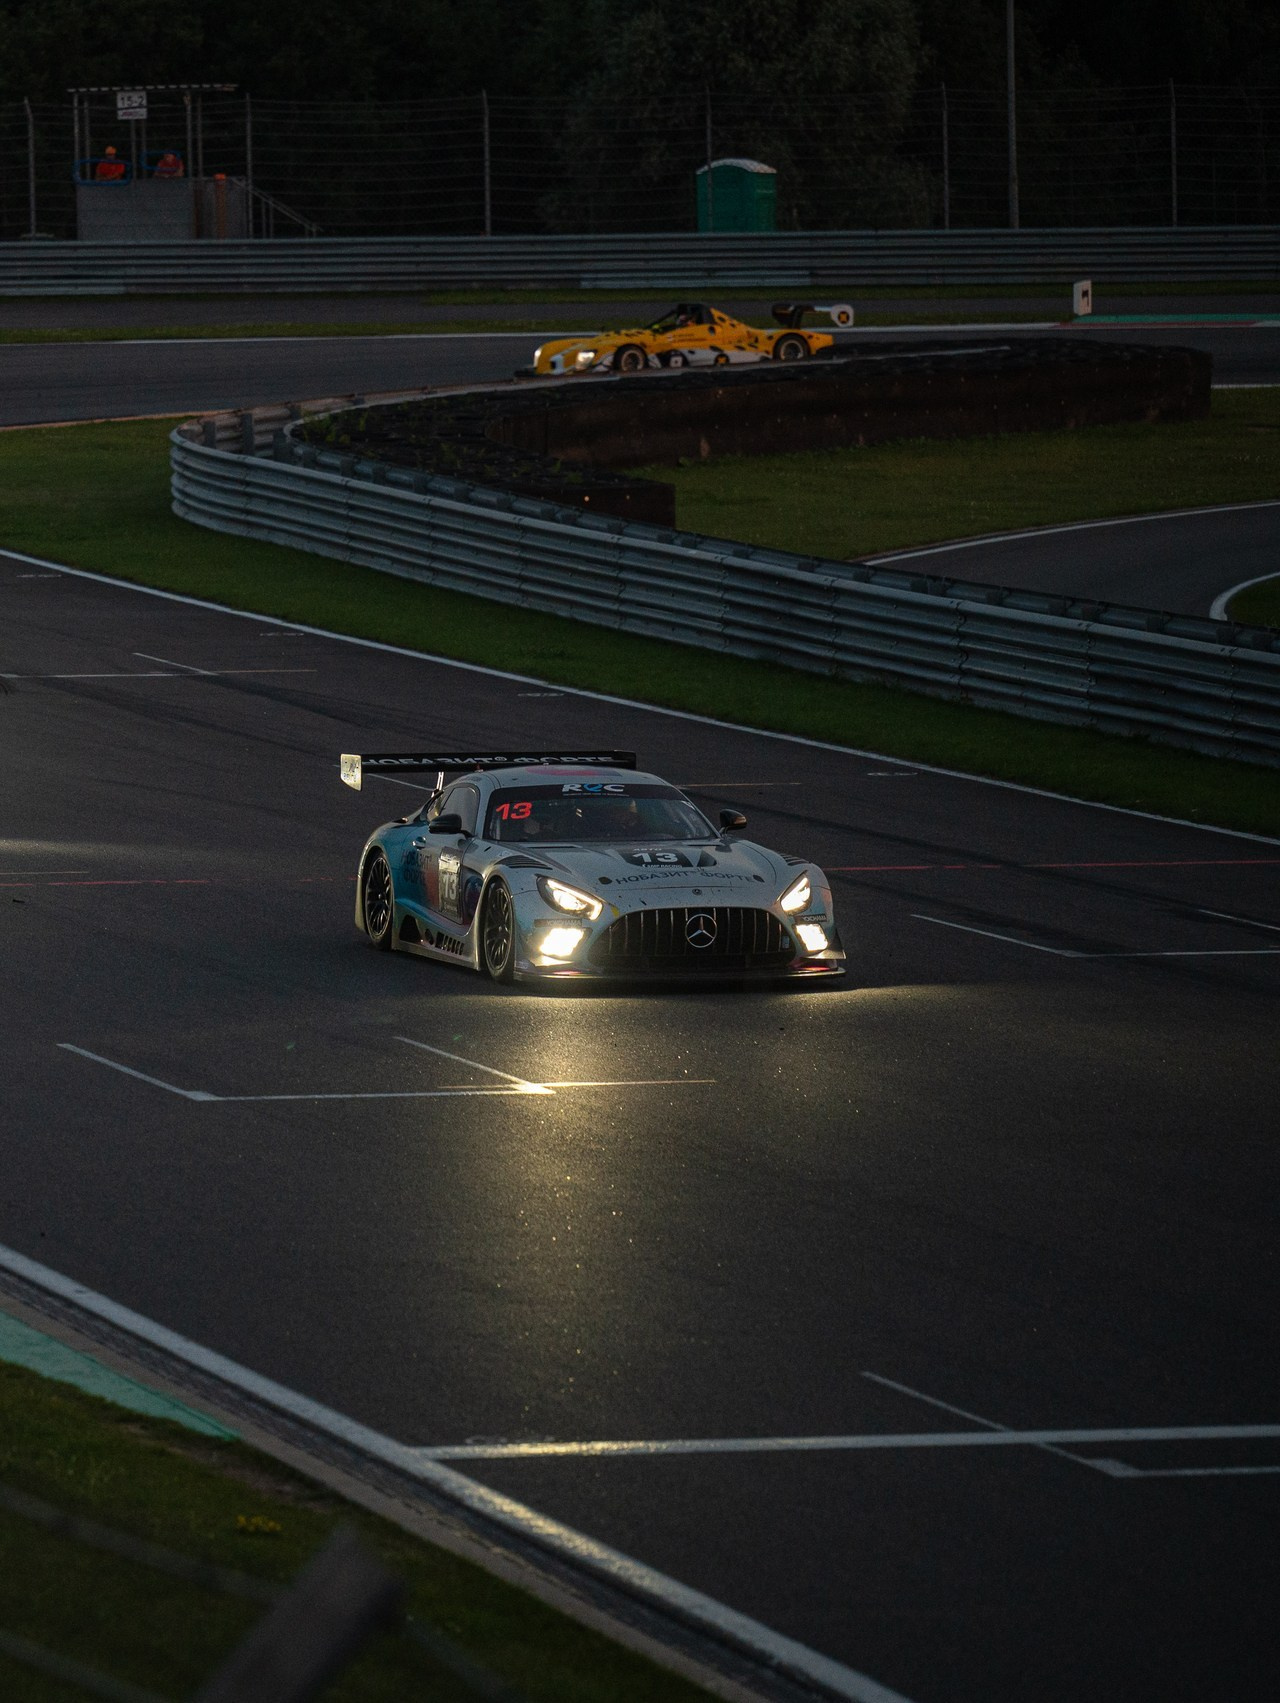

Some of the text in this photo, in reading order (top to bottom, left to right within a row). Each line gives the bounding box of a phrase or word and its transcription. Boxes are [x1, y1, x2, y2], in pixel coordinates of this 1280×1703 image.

[120, 95, 145, 107] 15-2
[496, 801, 532, 820] 13
[632, 852, 678, 863] 13
